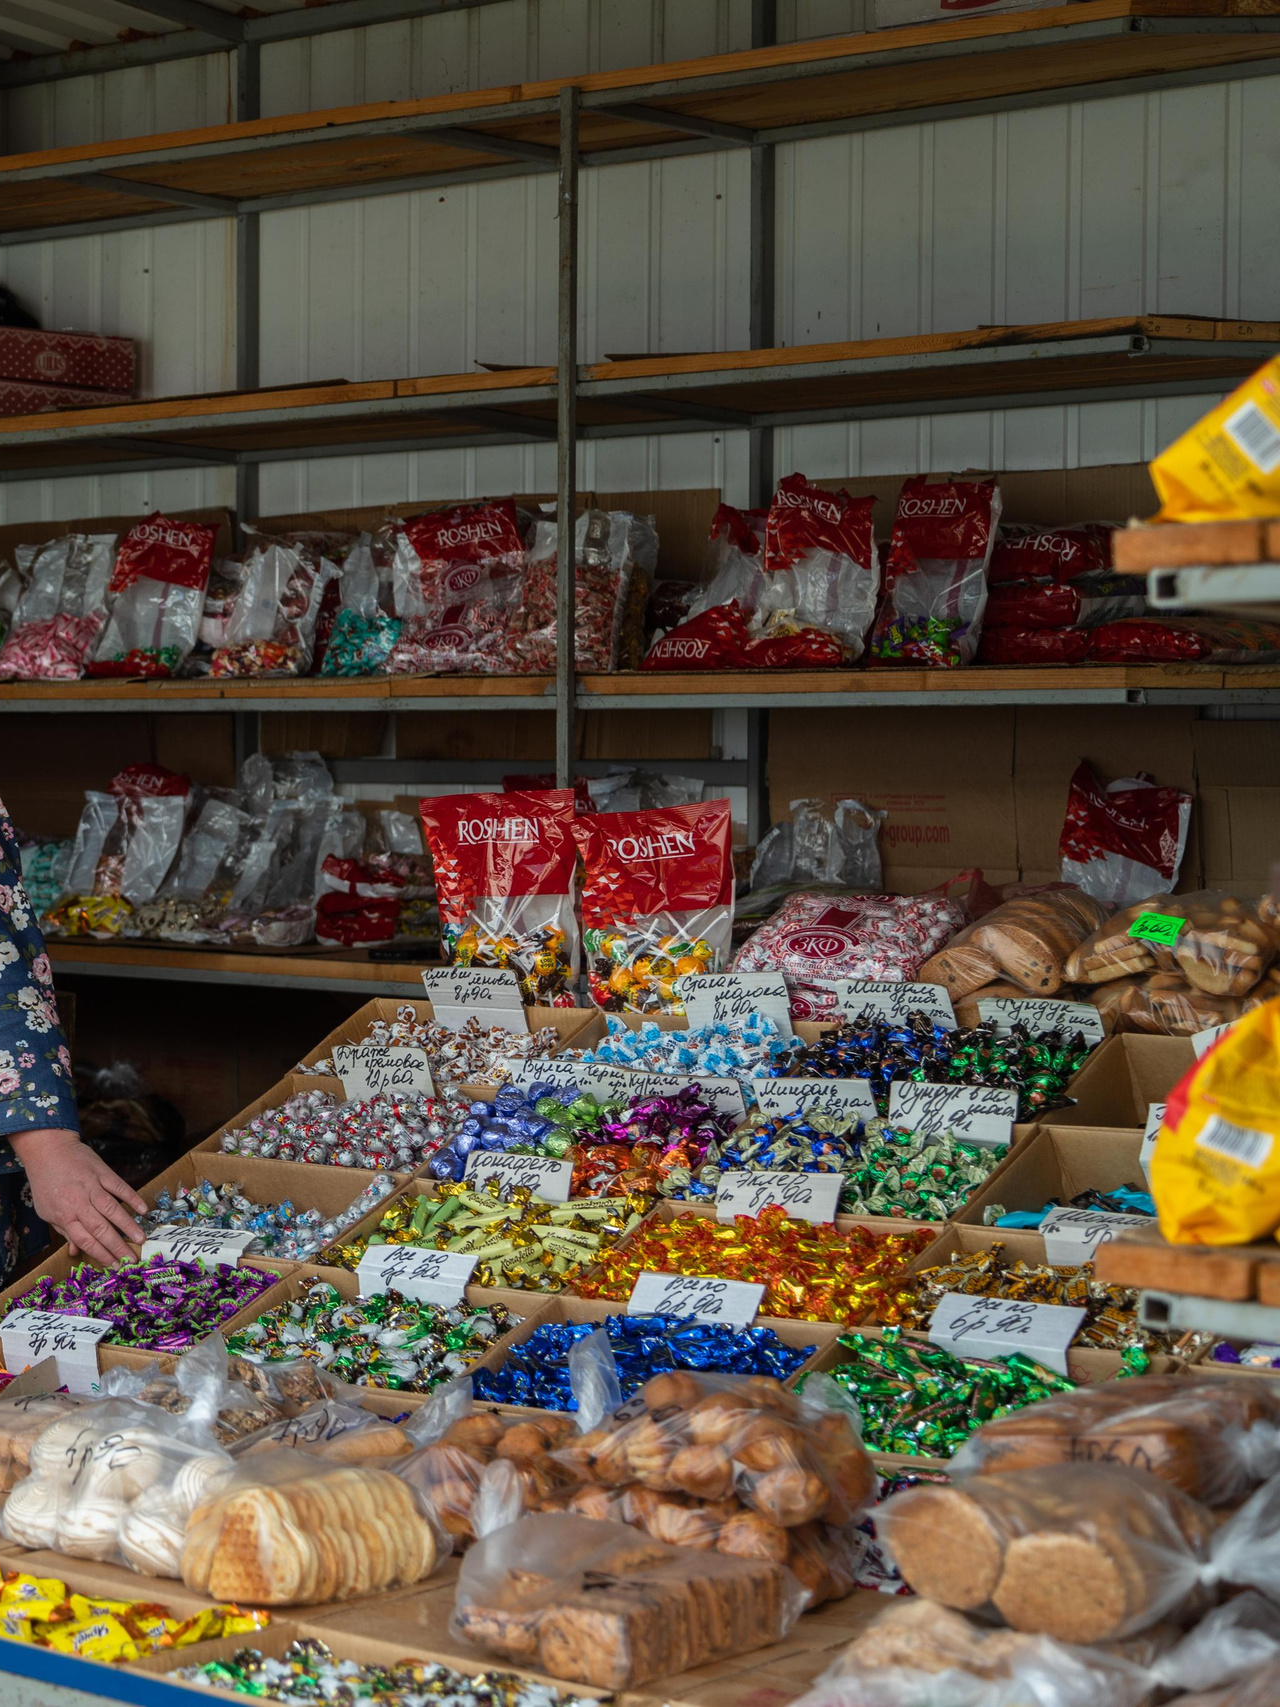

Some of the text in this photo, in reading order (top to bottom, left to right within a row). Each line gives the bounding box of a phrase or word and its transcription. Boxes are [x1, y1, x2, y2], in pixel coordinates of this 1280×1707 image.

[898, 498, 966, 519] ROSHEN
[437, 520, 502, 546] ROSHEN
[652, 638, 712, 659] ROSHEN
[458, 816, 540, 843] ROSHEN
[795, 938, 839, 959] ЗКФ
[760, 1082, 838, 1107] Миндаль
[737, 1174, 810, 1194] Эклер
